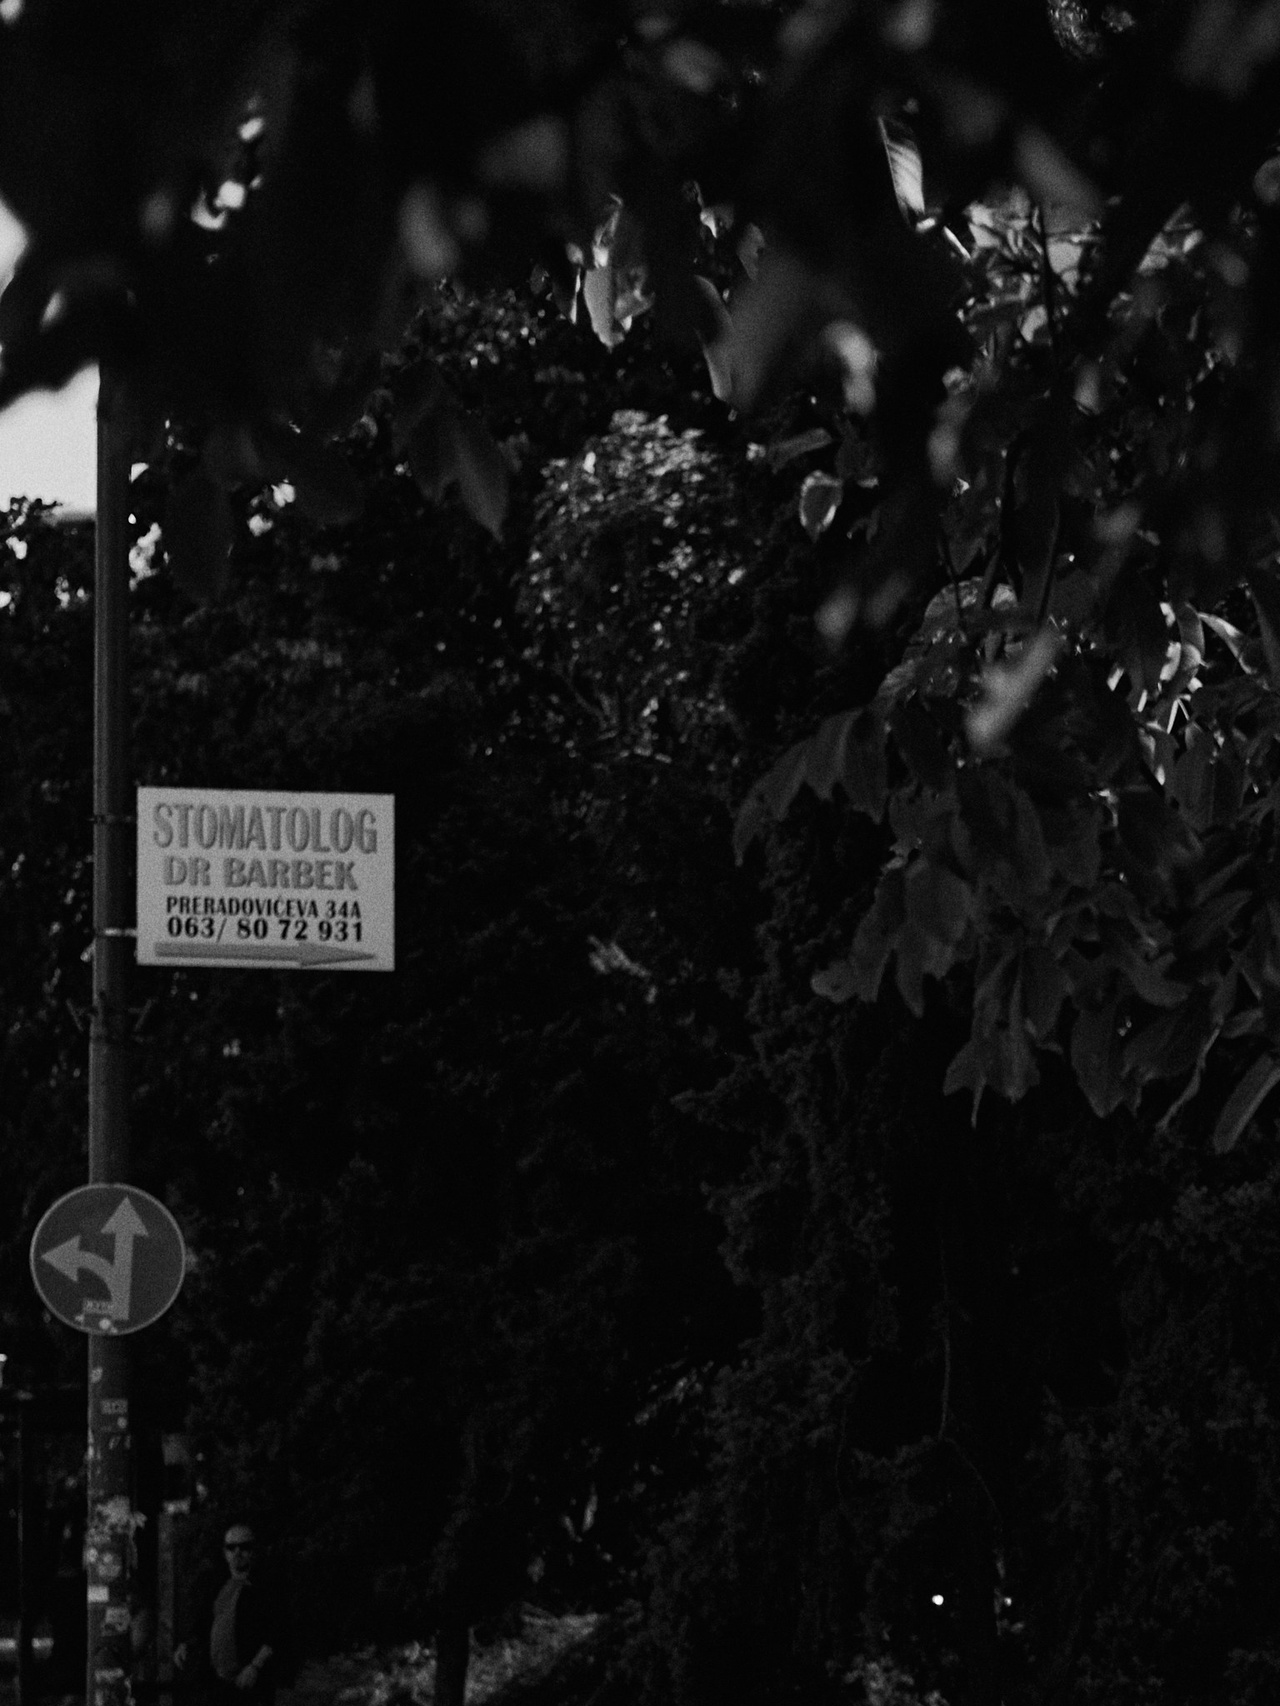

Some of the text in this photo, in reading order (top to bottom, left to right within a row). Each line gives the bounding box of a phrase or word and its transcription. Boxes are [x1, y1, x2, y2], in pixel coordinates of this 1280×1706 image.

[153, 803, 378, 854] STOMATOLOG
[163, 856, 358, 890] DR BARBEK
[166, 896, 361, 919] PRERADOVIĆEVA 34A
[236, 918, 269, 940] 80
[278, 919, 309, 942] 72
[318, 920, 363, 942] 931
